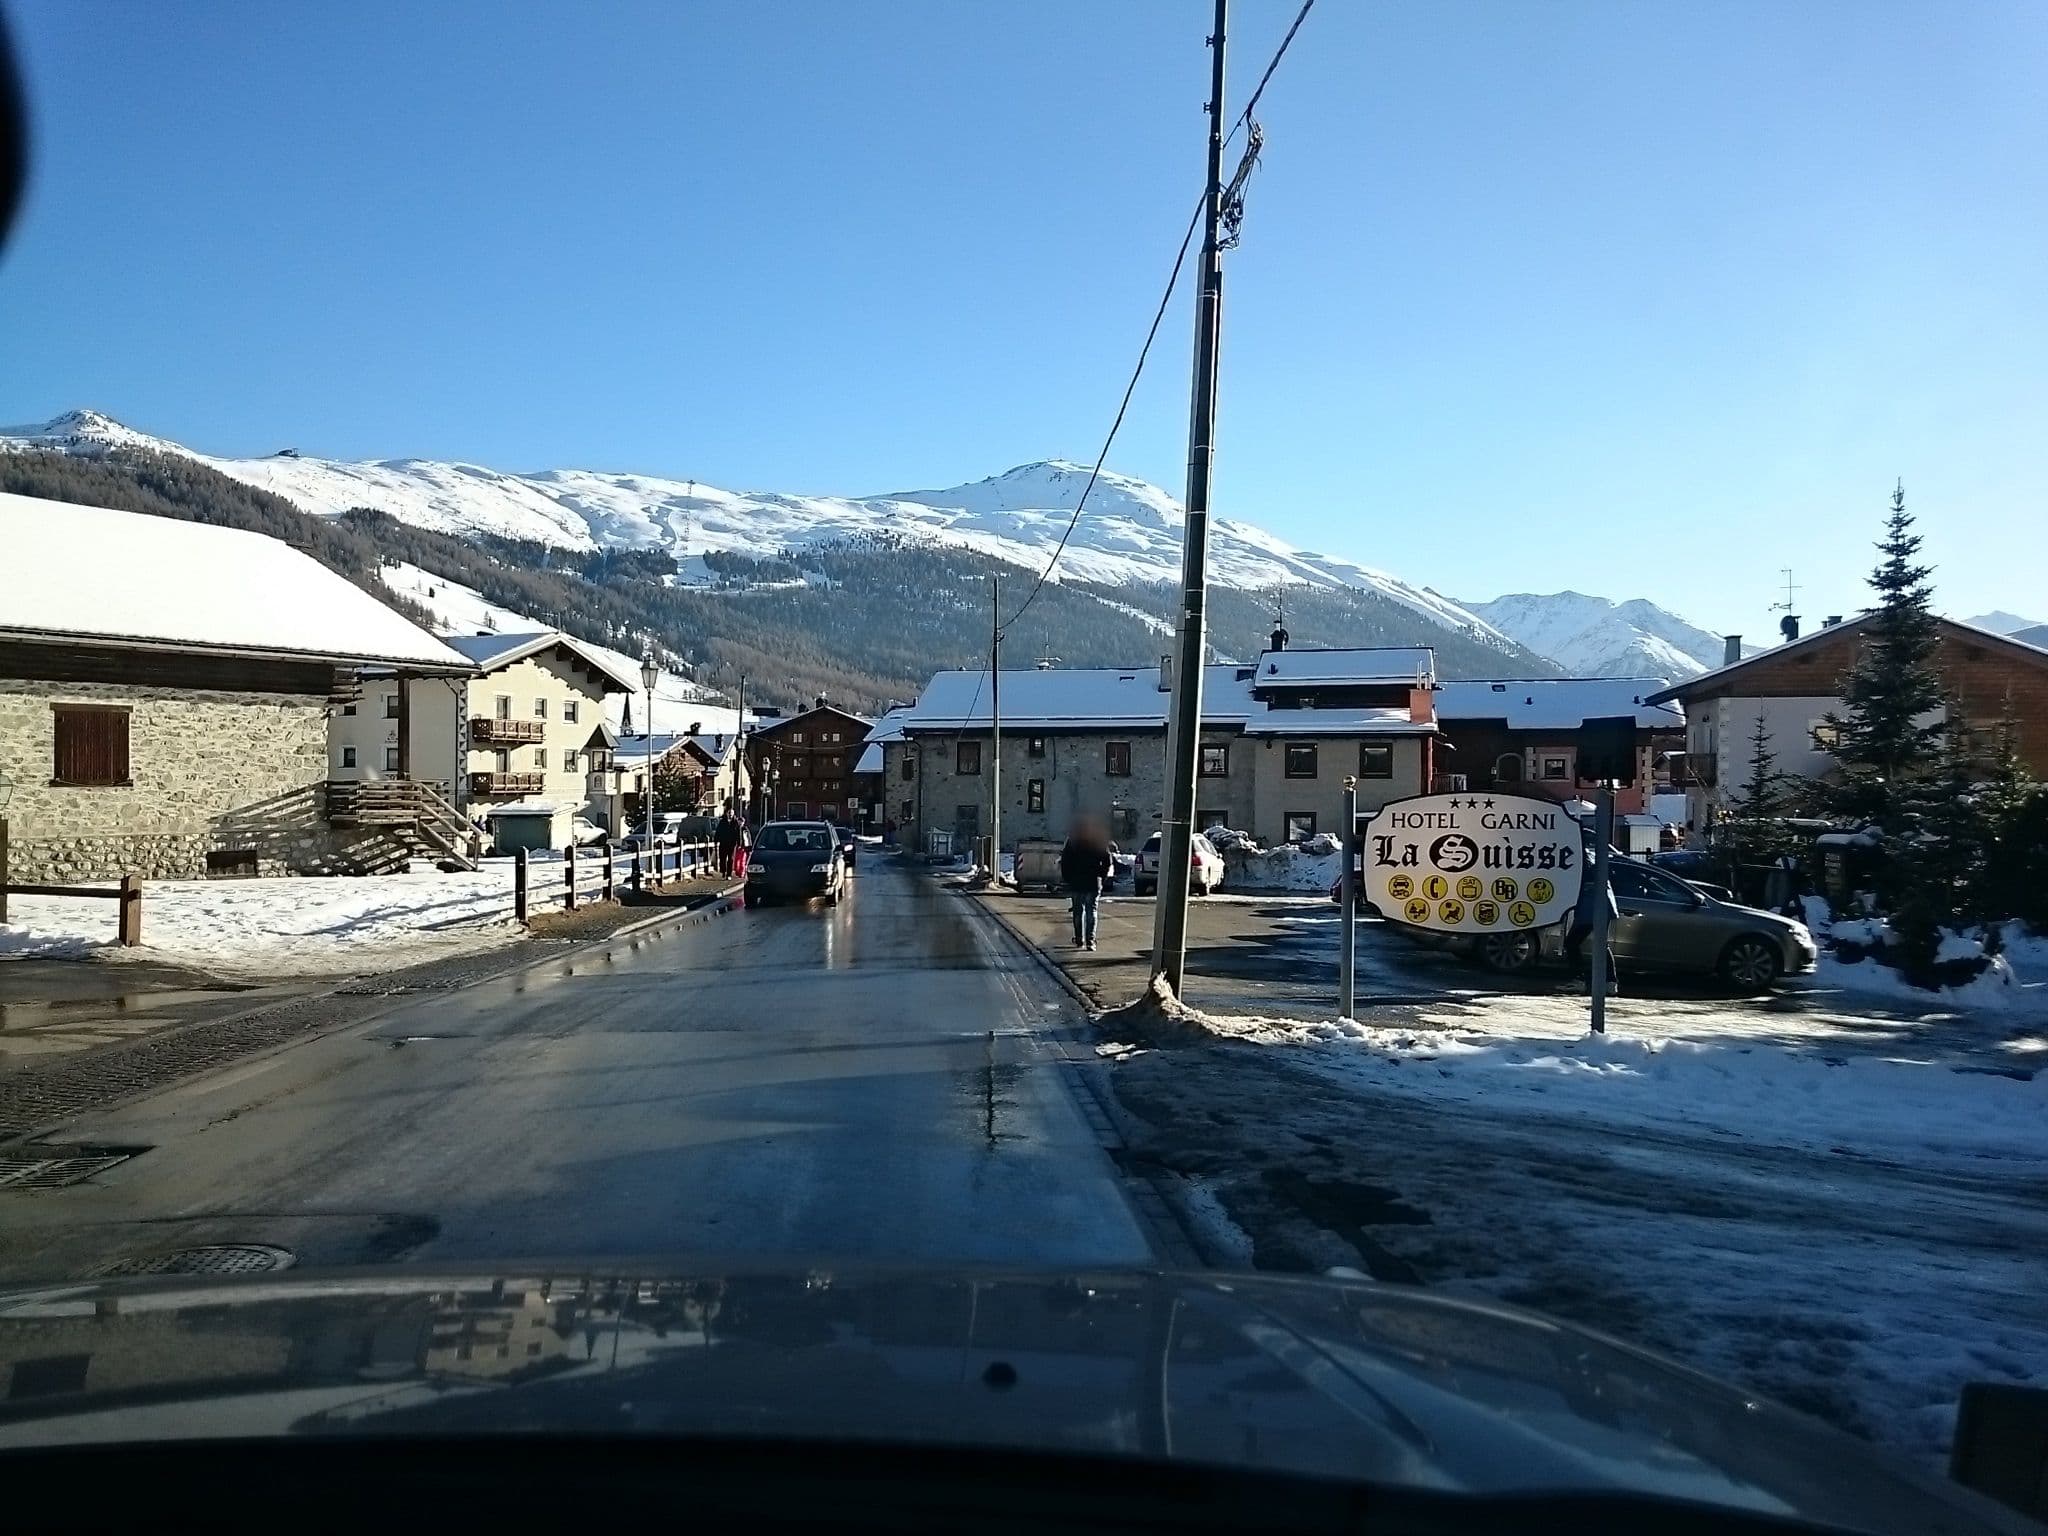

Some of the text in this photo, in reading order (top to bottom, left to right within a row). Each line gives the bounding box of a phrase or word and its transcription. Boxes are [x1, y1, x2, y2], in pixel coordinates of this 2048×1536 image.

[1391, 812, 1555, 830] HOTEL GARNI
[1372, 835, 1419, 868] La
